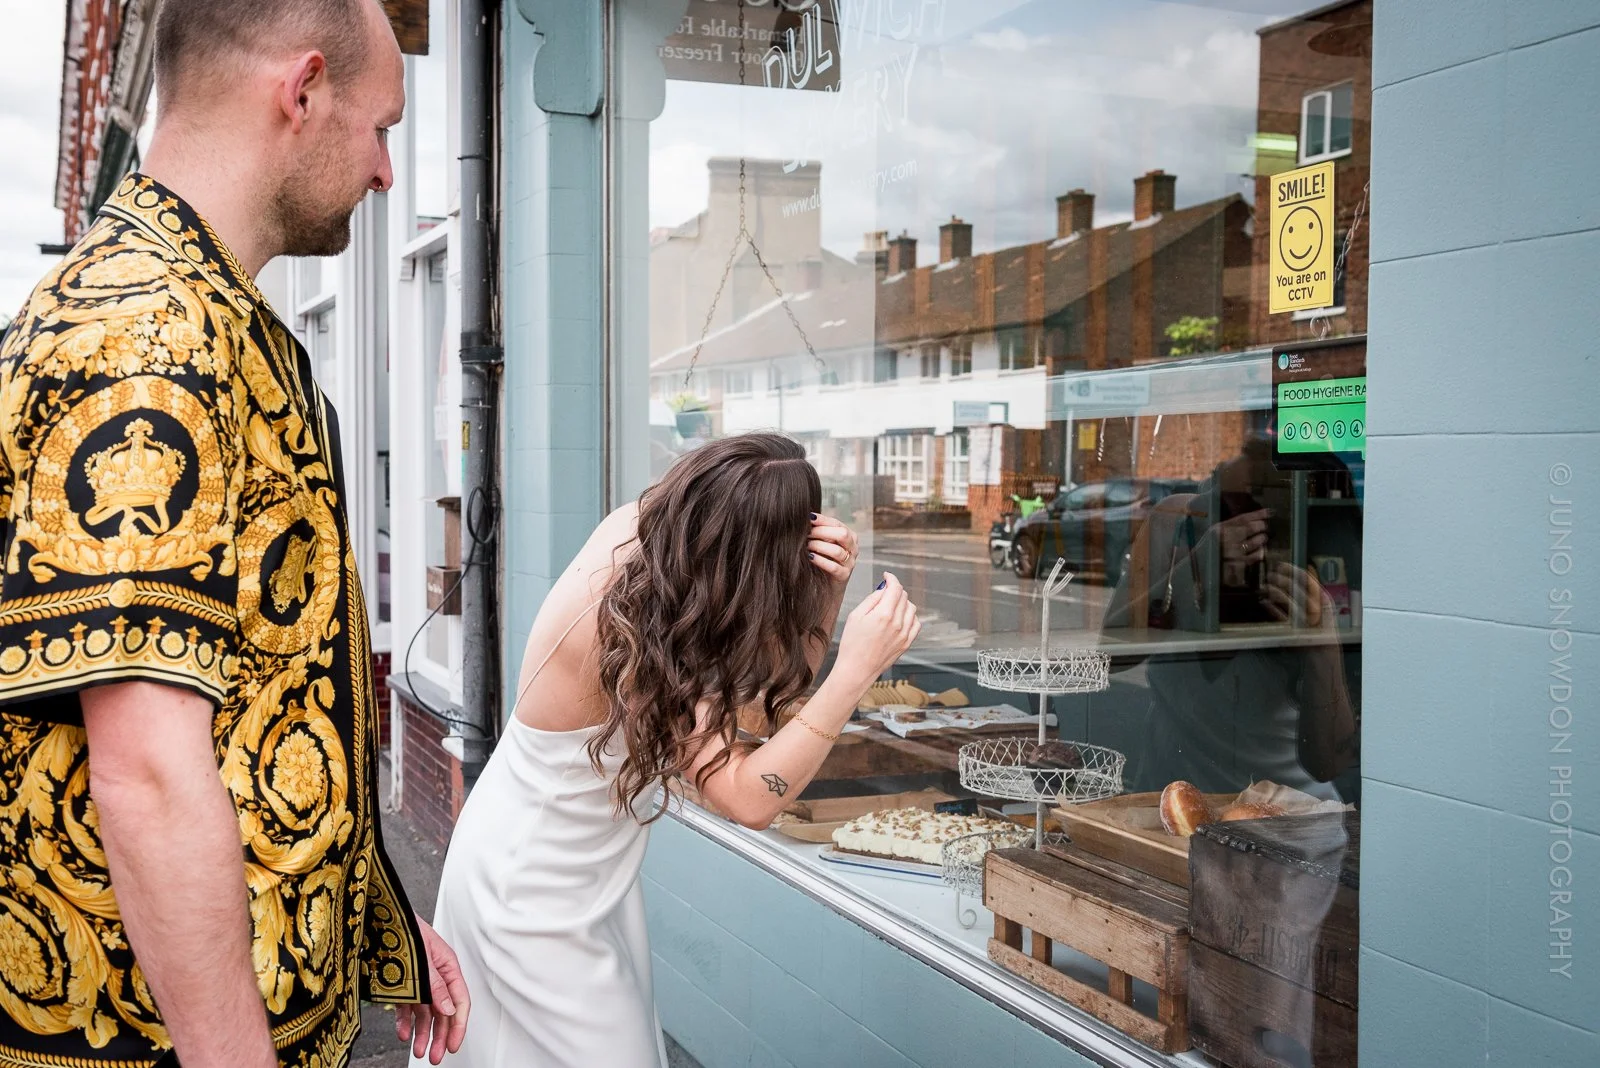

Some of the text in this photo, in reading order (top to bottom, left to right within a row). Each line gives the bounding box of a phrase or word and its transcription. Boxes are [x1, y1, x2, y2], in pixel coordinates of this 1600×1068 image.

[1278, 173, 1325, 202] SMILE!
[1277, 271, 1326, 287] You are on
[1288, 286, 1314, 301] CCTV
[1284, 388, 1311, 401] FOOD
[1313, 385, 1353, 399] HYGIENE
